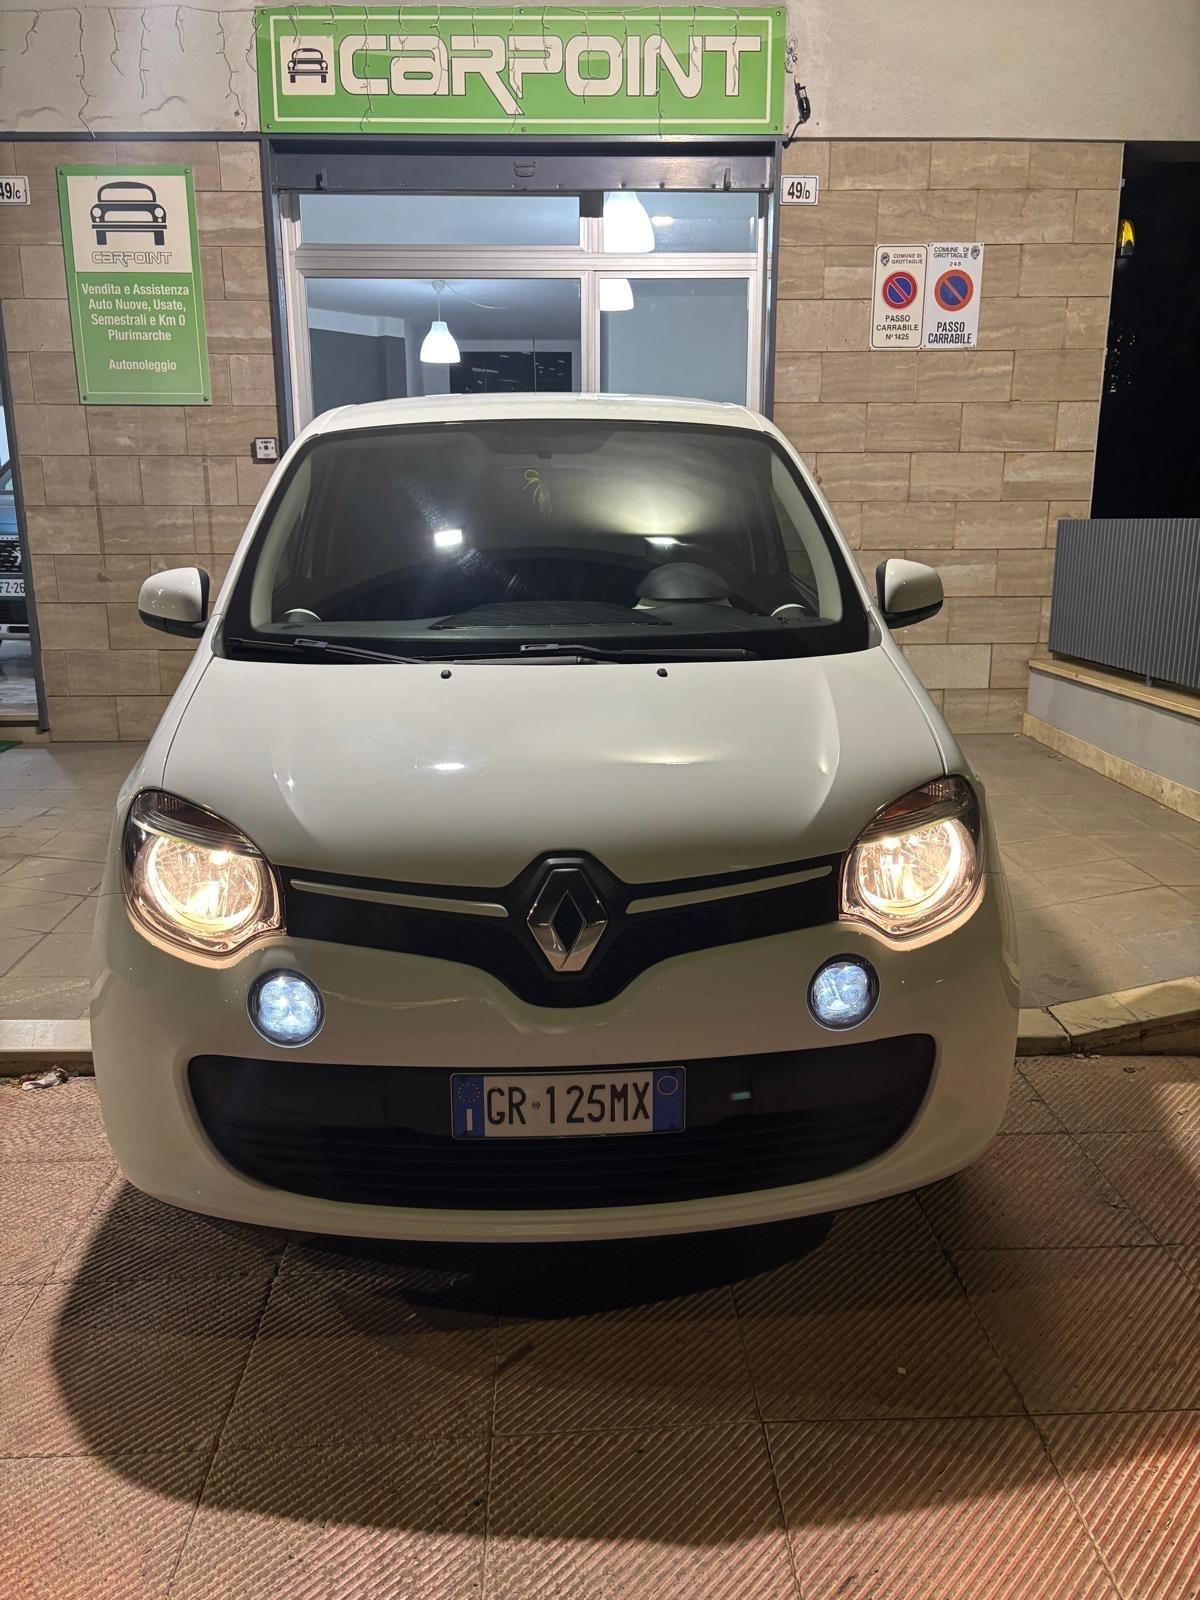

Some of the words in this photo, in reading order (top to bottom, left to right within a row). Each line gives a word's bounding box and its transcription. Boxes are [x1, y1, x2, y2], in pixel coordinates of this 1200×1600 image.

[81, 283, 121, 294] Vendita
[124, 286, 130, 294] e
[133, 284, 189, 295] Assistenza
[88, 299, 112, 310] Auto
[115, 299, 151, 312] Nuove,
[153, 299, 186, 312] Usate,
[91, 314, 147, 326] Semestrali
[150, 317, 156, 326] e
[159, 314, 176, 326] Km
[885, 314, 911, 322] PASSO
[936, 322, 965, 332] PASSO
[108, 329, 171, 341] Plurimarche
[928, 333, 972, 344] CARRABILE
[108, 359, 176, 372] Autonoleggio
[487, 1086, 527, 1125] GR
[546, 1082, 650, 1123] 125MX
